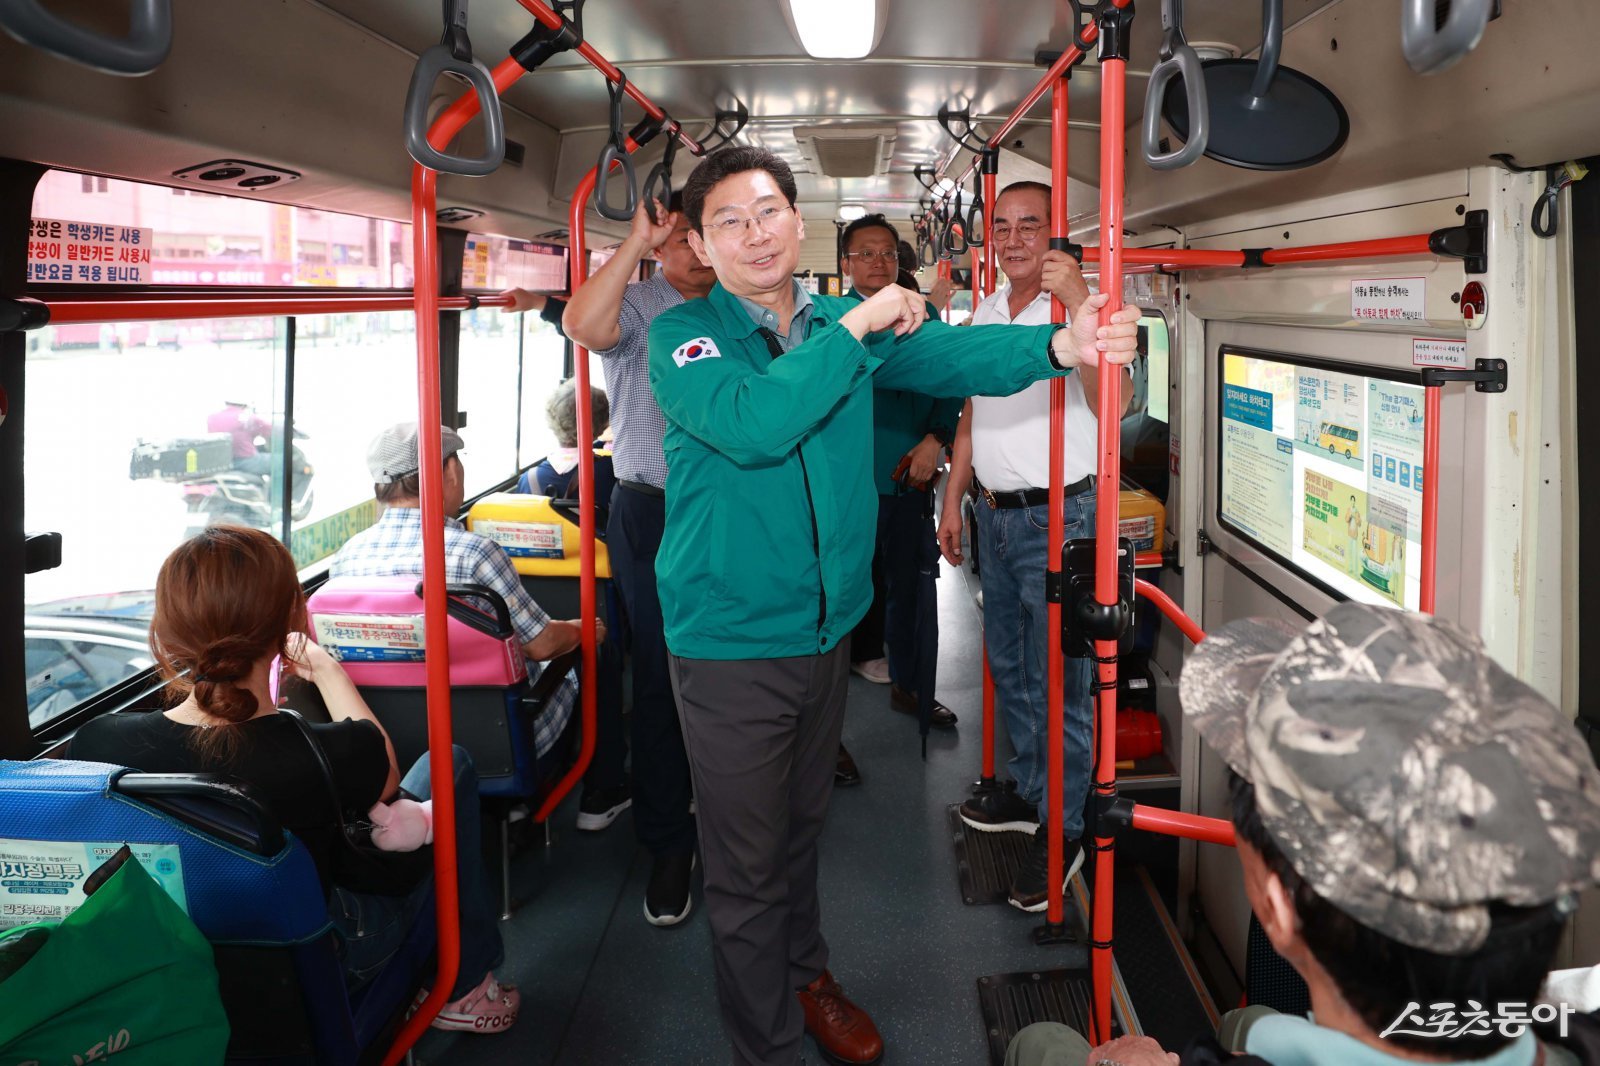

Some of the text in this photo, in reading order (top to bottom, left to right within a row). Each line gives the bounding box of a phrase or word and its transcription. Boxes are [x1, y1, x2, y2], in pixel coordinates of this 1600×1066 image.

[67, 223, 115, 242] 학생카드
[120, 228, 141, 245] 사용
[66, 244, 114, 262] 일반카드
[118, 247, 150, 264] 사용시
[78, 265, 102, 282] 적용
[106, 266, 142, 282] 됩니다.
